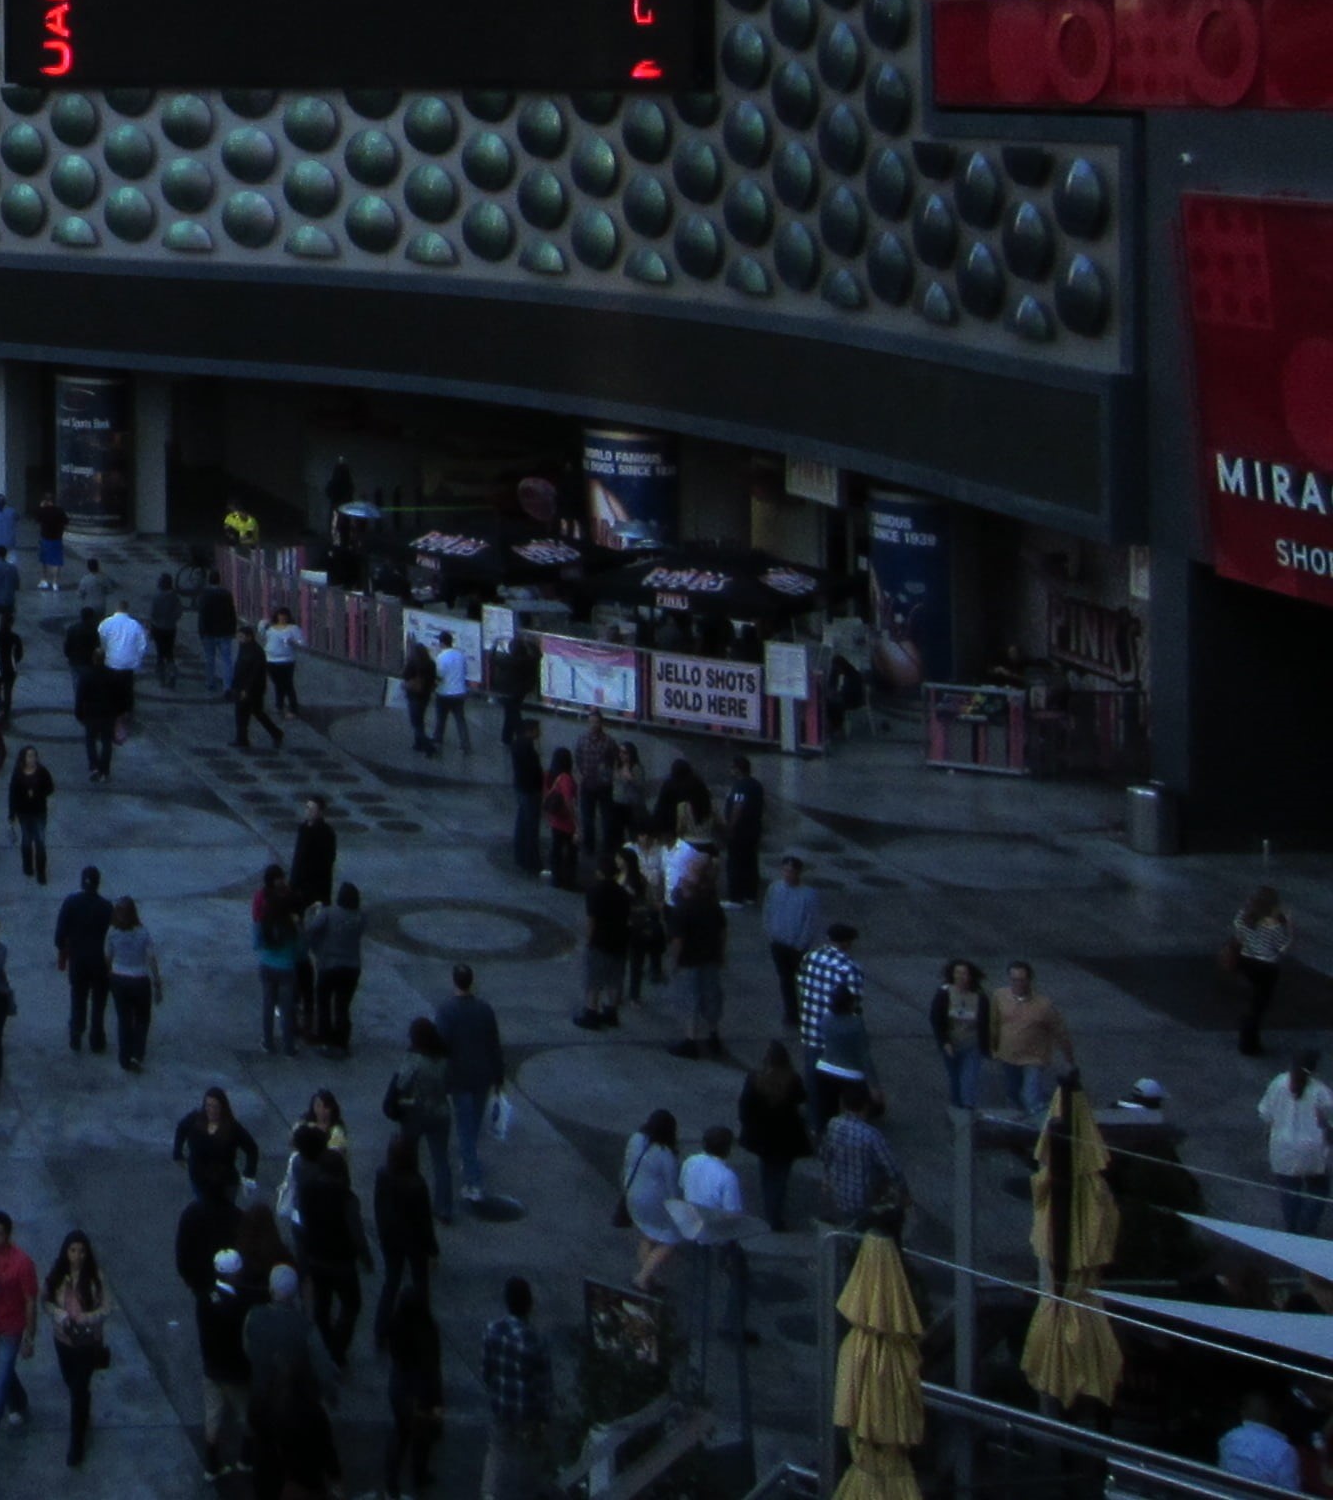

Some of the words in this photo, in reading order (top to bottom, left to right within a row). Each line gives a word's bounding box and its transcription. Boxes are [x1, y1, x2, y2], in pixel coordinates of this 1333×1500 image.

[615, 452, 661, 464] FAMOUS
[618, 464, 653, 477] SINCE
[1216, 453, 1333, 516] MIRA
[657, 662, 701, 686] JELLO
[706, 668, 756, 694] SHOTS
[664, 687, 703, 712] SOLD
[708, 695, 748, 719] HERE
